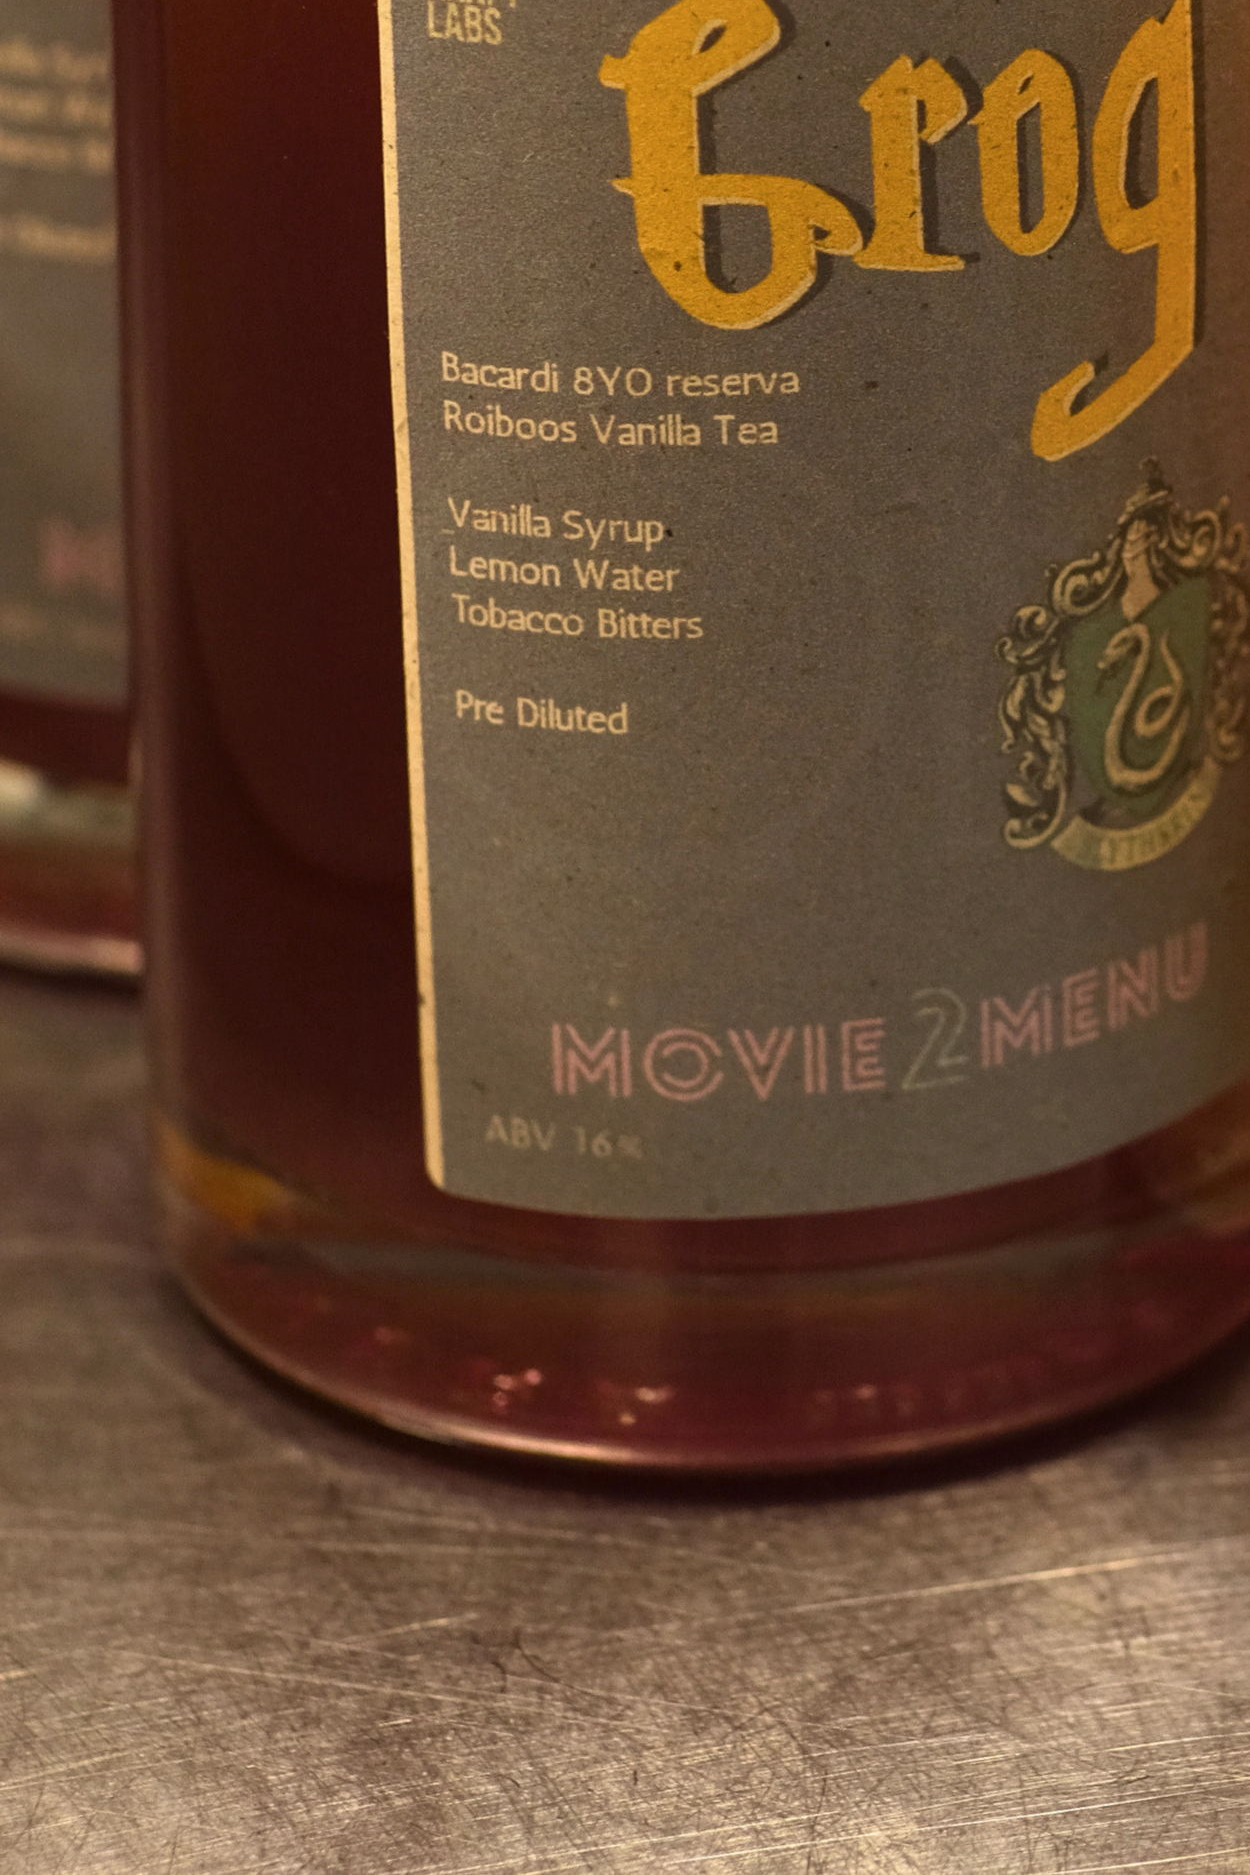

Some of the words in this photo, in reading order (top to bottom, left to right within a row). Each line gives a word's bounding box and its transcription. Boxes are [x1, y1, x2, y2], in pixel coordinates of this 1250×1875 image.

[427, 6, 502, 45] LABS
[441, 351, 559, 393] Bacardi
[573, 366, 652, 397] 8YO
[667, 371, 800, 397] reserva
[443, 400, 577, 443] Roiboos
[590, 413, 701, 446] Vanilla
[714, 414, 779, 445] Tea
[447, 497, 552, 538] Vanilla
[562, 510, 665, 551] Syrup
[449, 545, 561, 587] Lemon
[573, 558, 680, 592] Water
[452, 593, 584, 636] Tobacco
[597, 608, 704, 640] Bitters
[455, 689, 504, 725] Pre
[516, 697, 629, 735] Diluted
[485, 1113, 556, 1152] ABV
